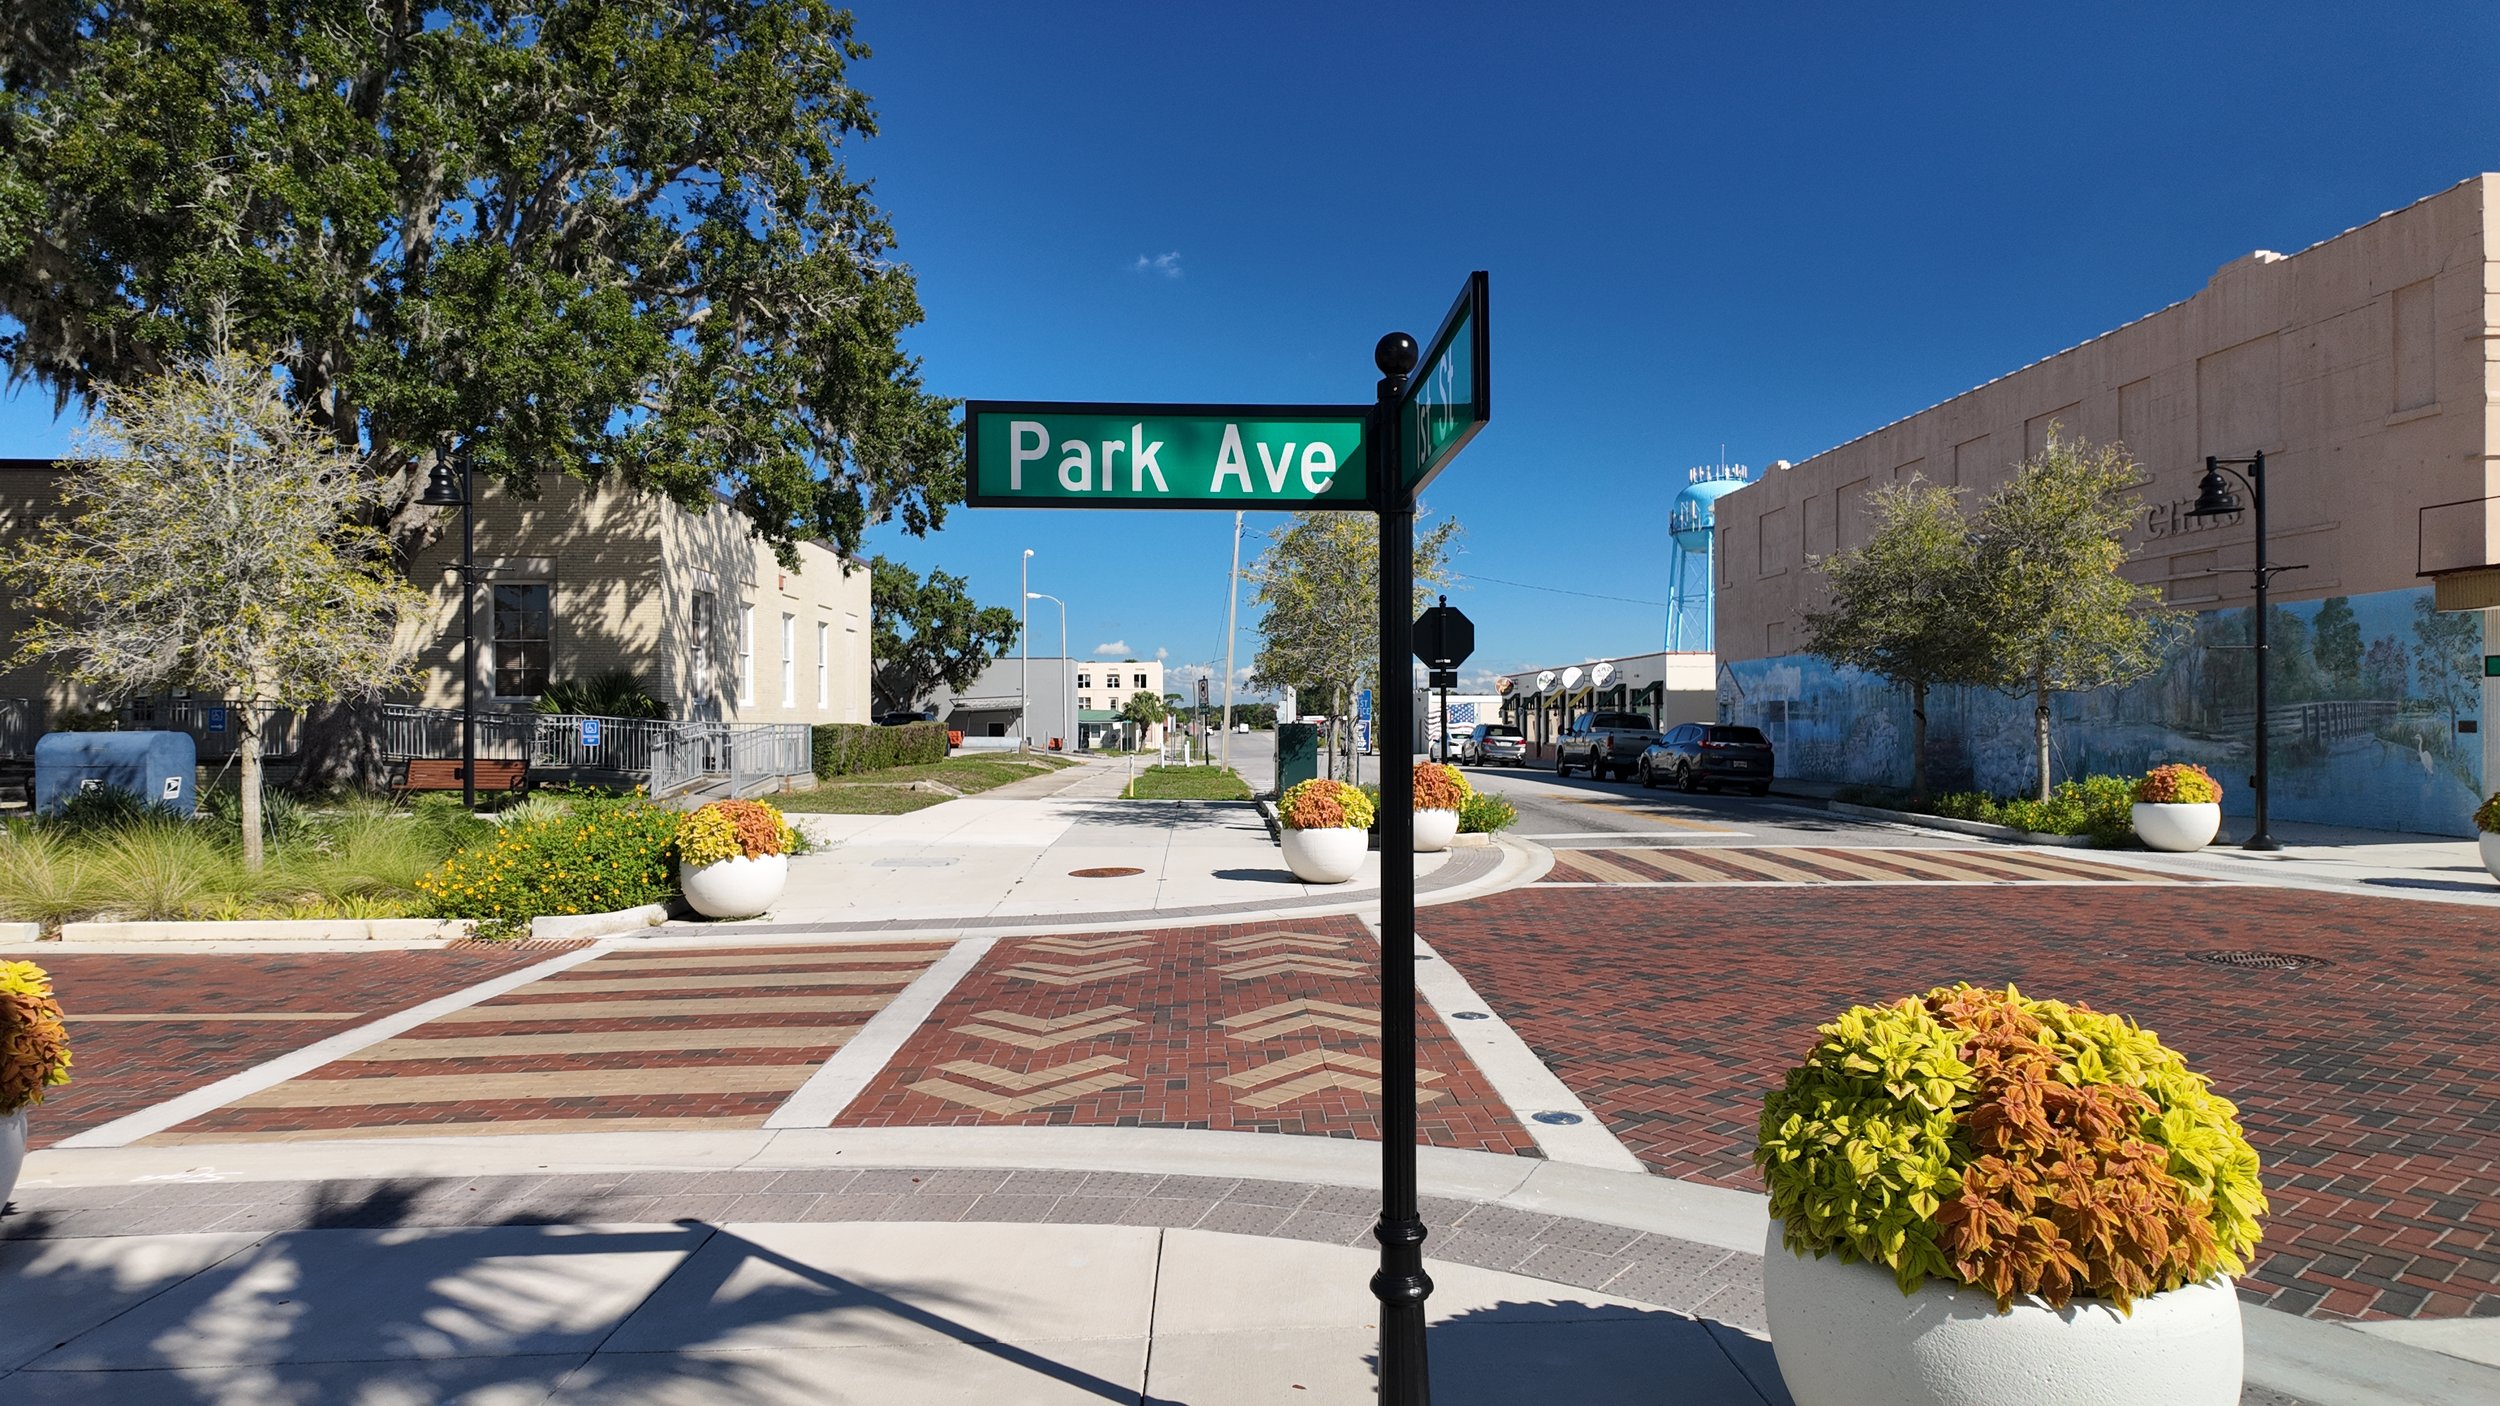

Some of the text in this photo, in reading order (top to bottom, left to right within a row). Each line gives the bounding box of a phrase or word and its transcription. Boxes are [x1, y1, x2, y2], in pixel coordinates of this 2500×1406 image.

[1414, 344, 1454, 469] 1st St
[1009, 420, 1338, 495] Park Ave
